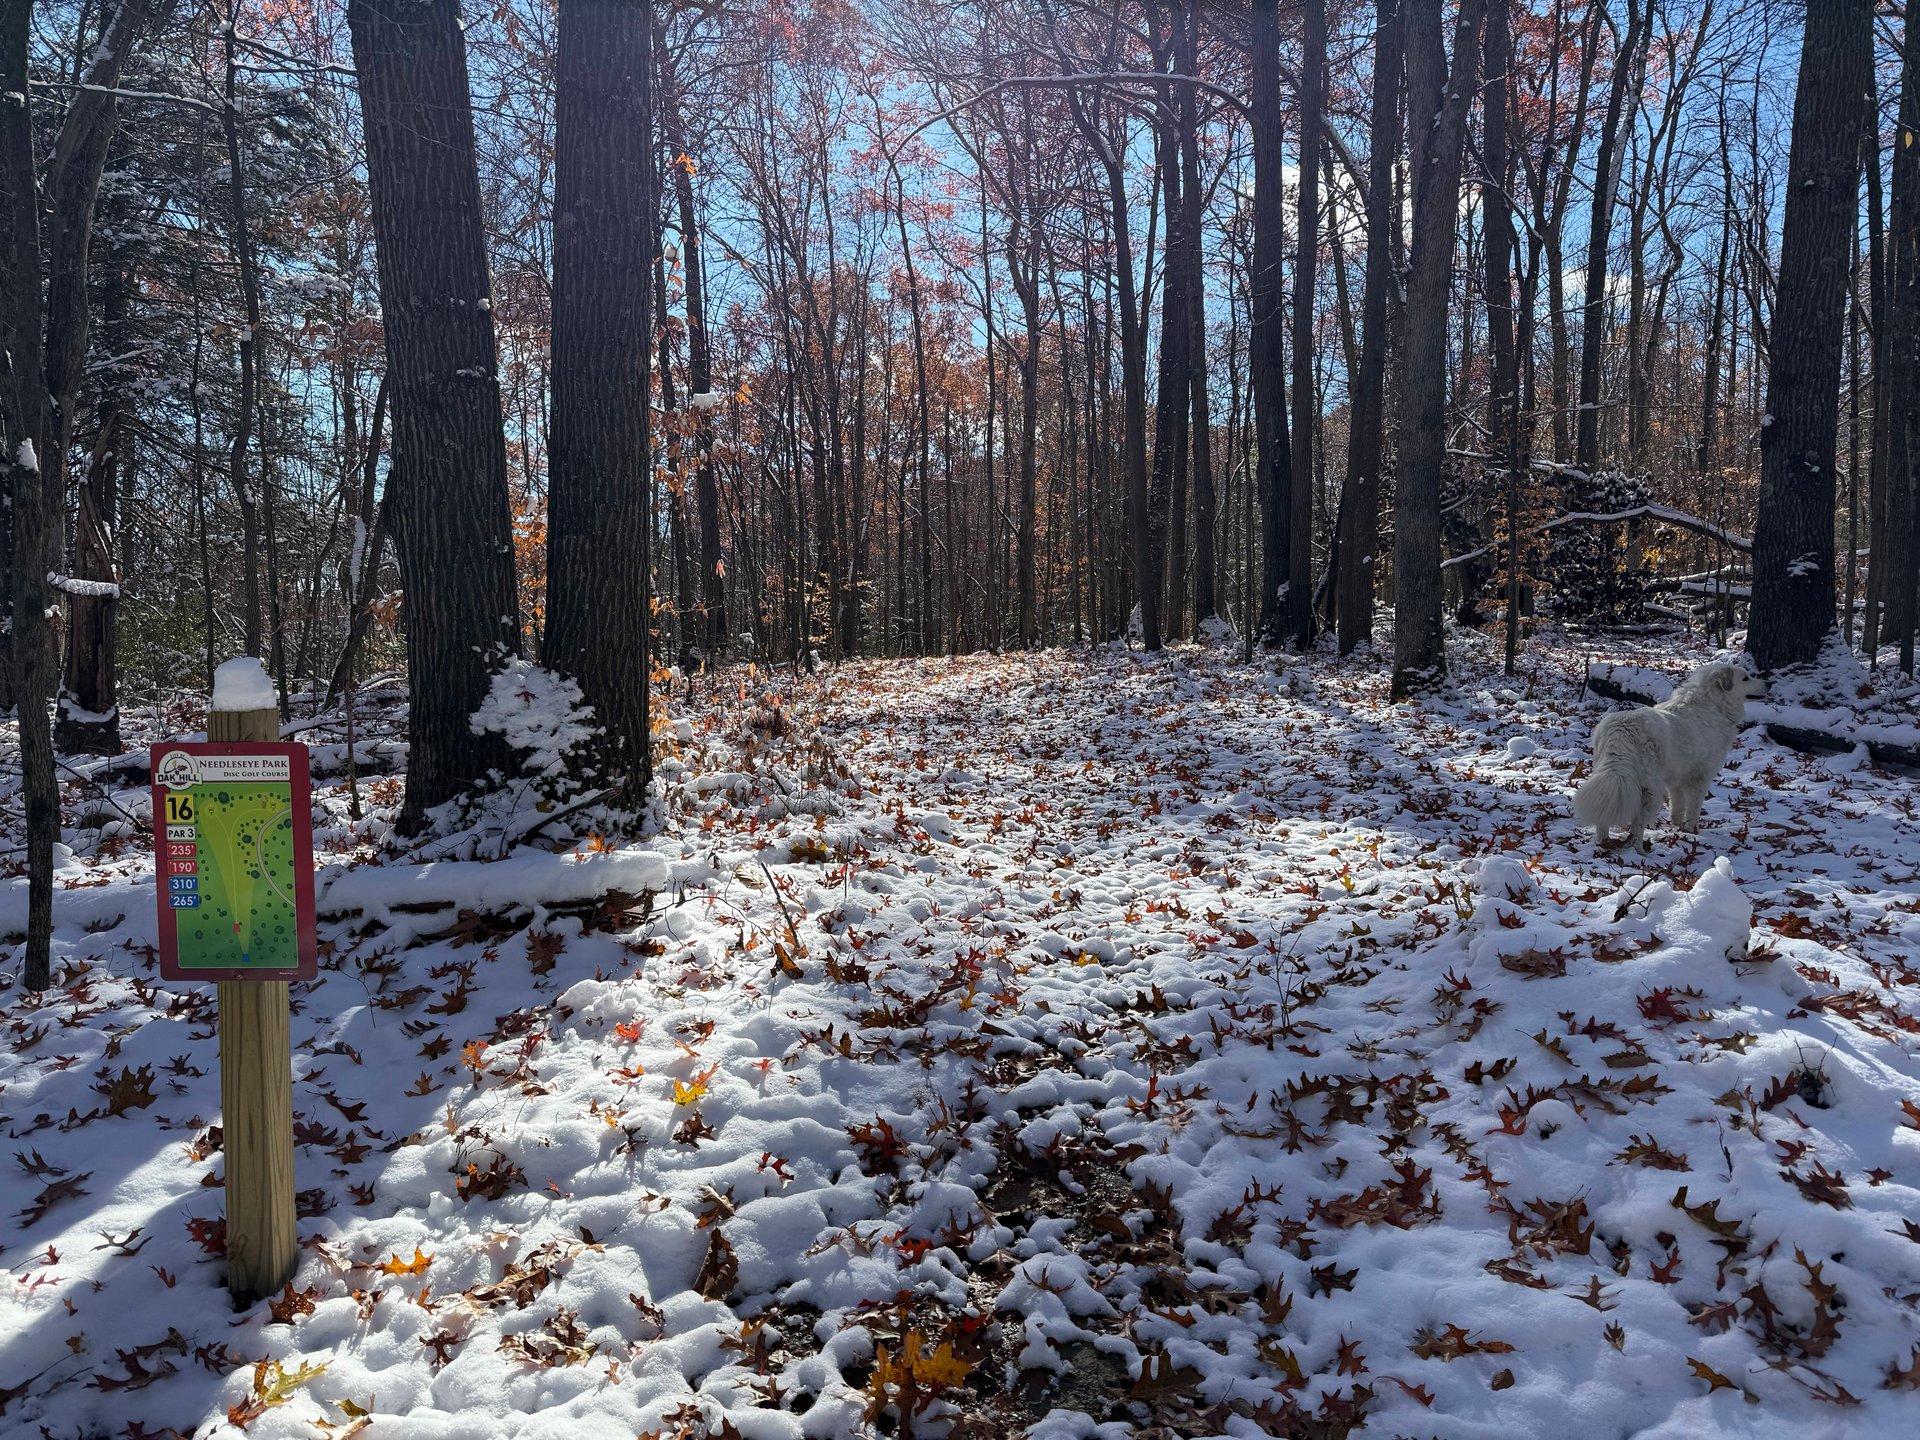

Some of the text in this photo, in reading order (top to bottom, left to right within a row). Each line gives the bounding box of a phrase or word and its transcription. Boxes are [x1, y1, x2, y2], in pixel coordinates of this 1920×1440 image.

[199, 760, 288, 768] NEEDLESEYE PARK
[158, 774, 200, 782] OAK HILL
[167, 797, 193, 820] 16
[168, 828, 195, 838] PAR 3
